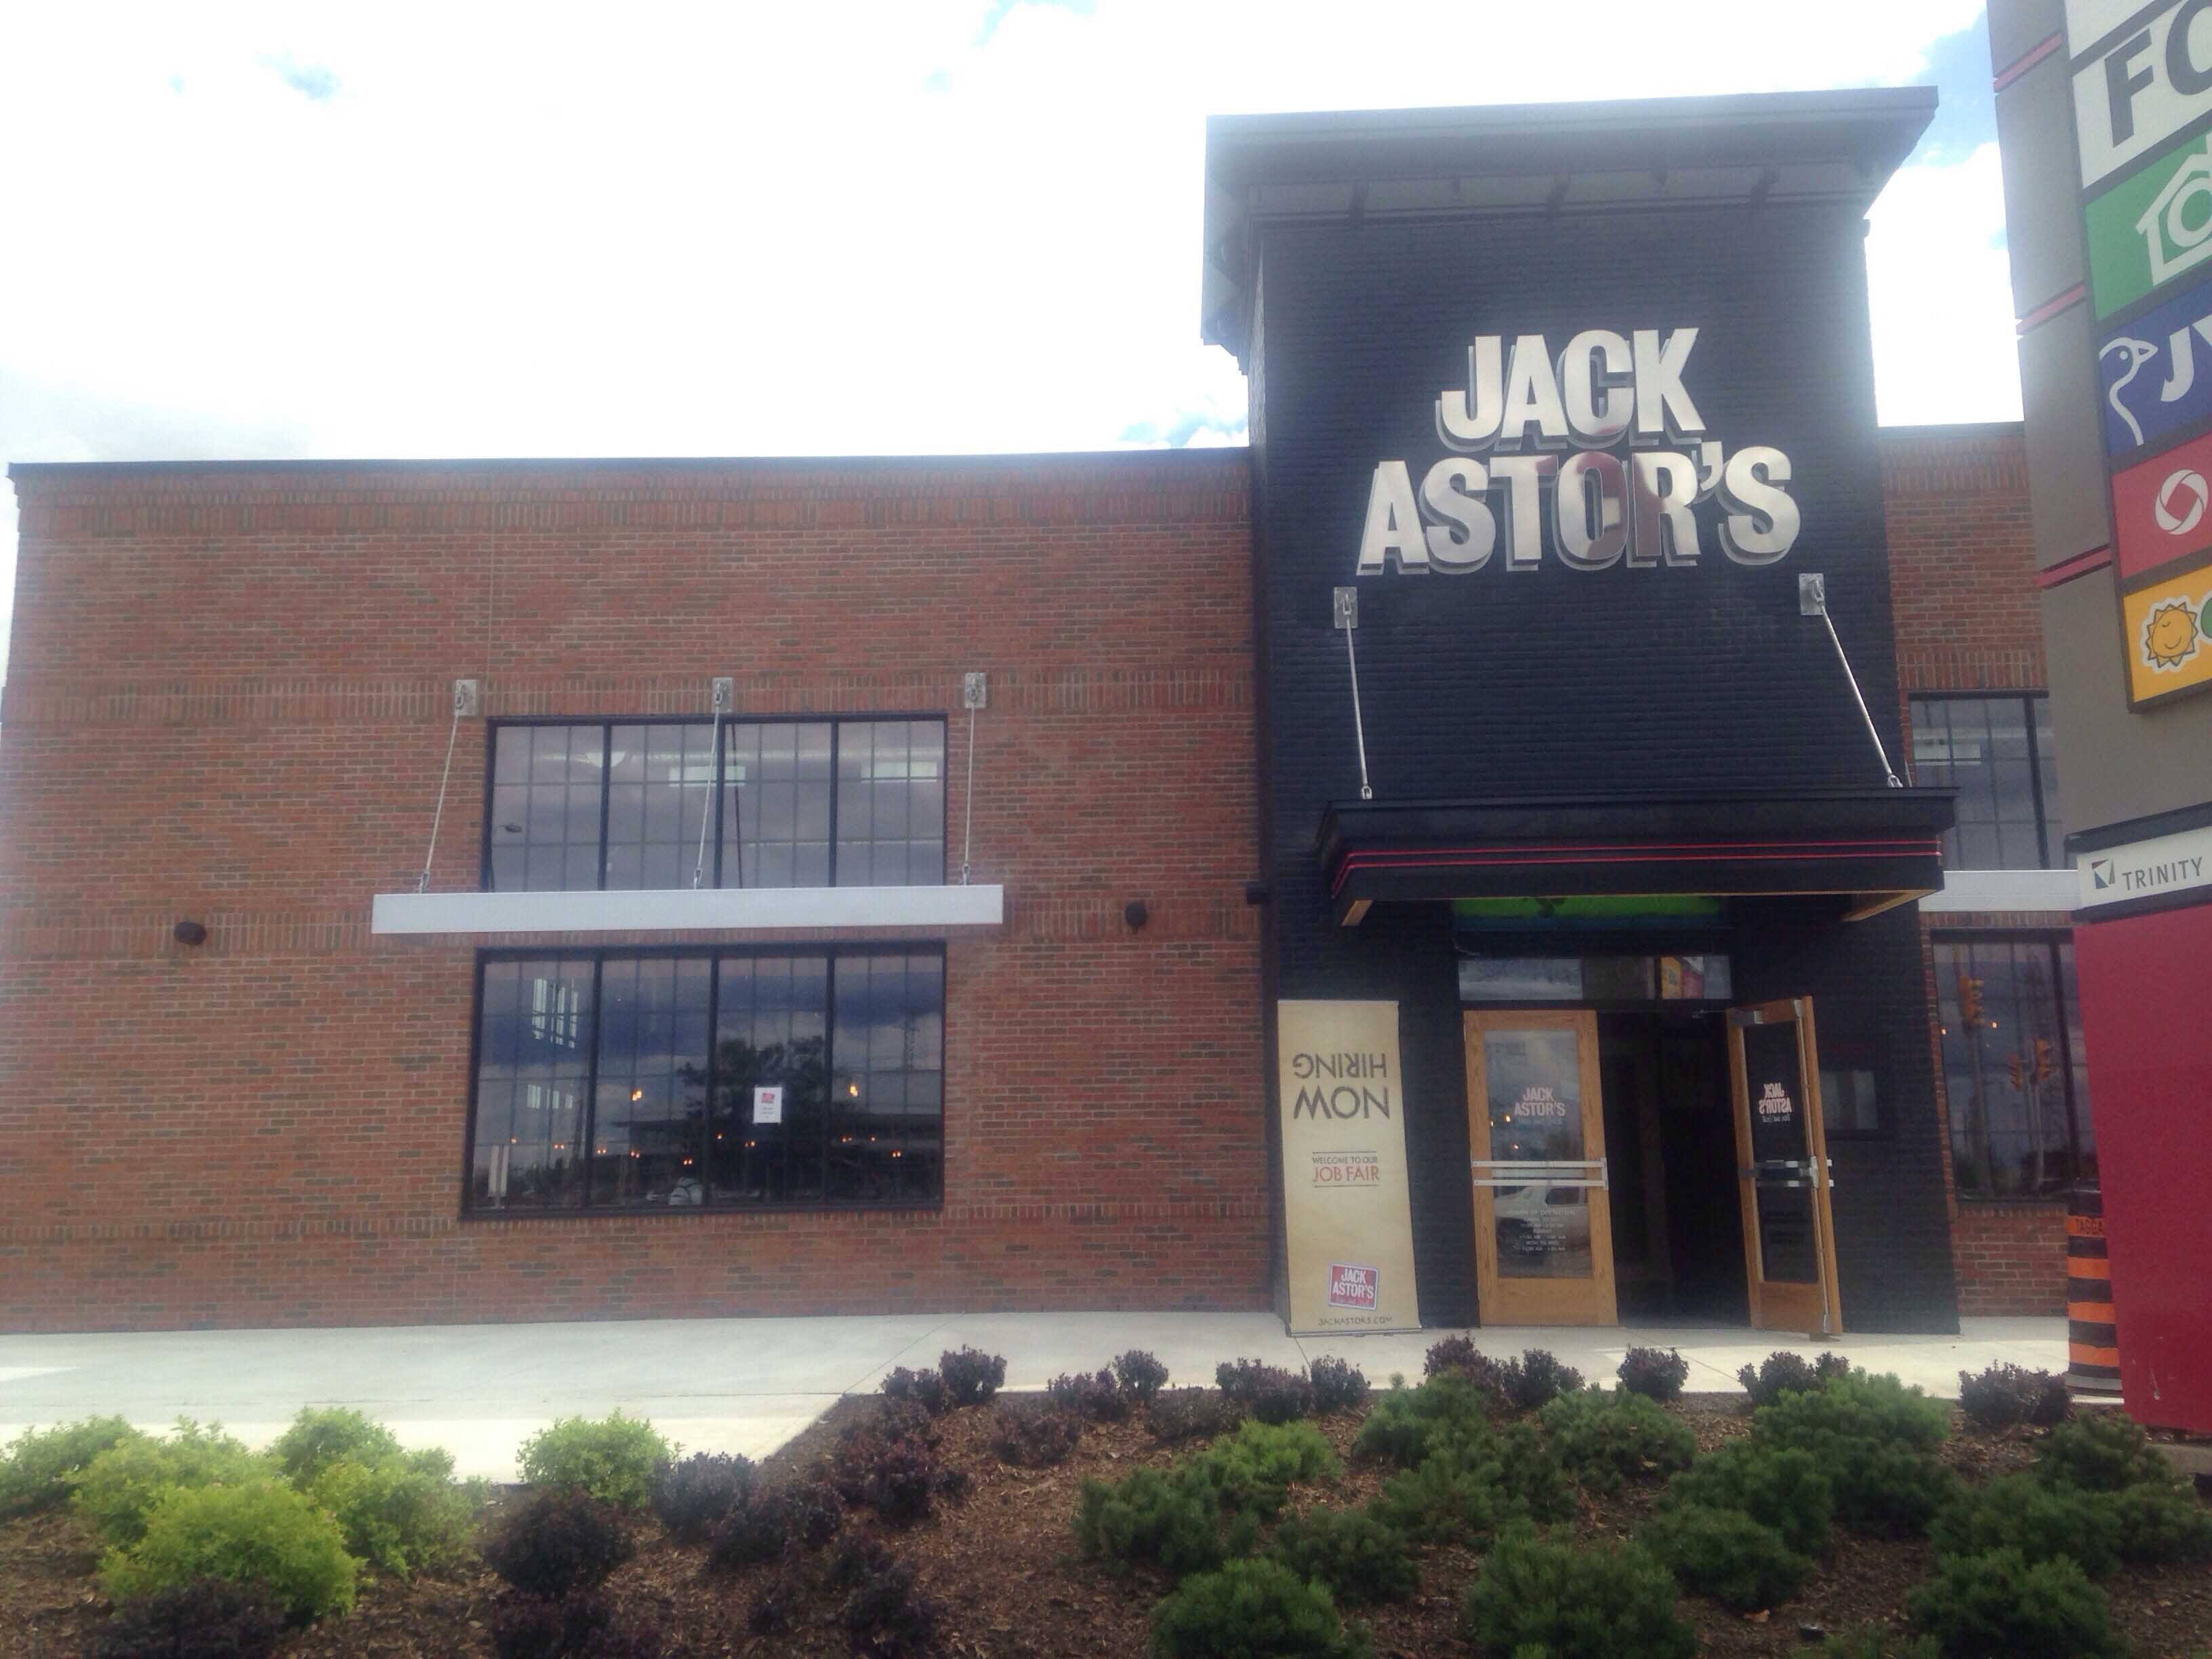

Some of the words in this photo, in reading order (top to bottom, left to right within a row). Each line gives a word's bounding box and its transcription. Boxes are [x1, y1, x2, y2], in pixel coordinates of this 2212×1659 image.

[2160, 314, 2212, 402] J
[1436, 327, 1706, 451] JACK
[1357, 441, 1801, 575] ASTOR'S
[2122, 857, 2202, 890] TRINITY
[1293, 1053, 1387, 1079] HIRING
[1294, 1085, 1390, 1120] NOW
[1522, 1087, 1554, 1101] JACK
[1514, 1101, 1566, 1117] ASTOR'S
[1312, 1156, 1349, 1164] WELCOME
[1351, 1156, 1361, 1164] TO
[1312, 1166, 1342, 1182] JOB
[1346, 1165, 1379, 1181] FAIR
[1340, 1267, 1367, 1284] JACK
[1332, 1282, 1374, 1299] ASTOR'S
